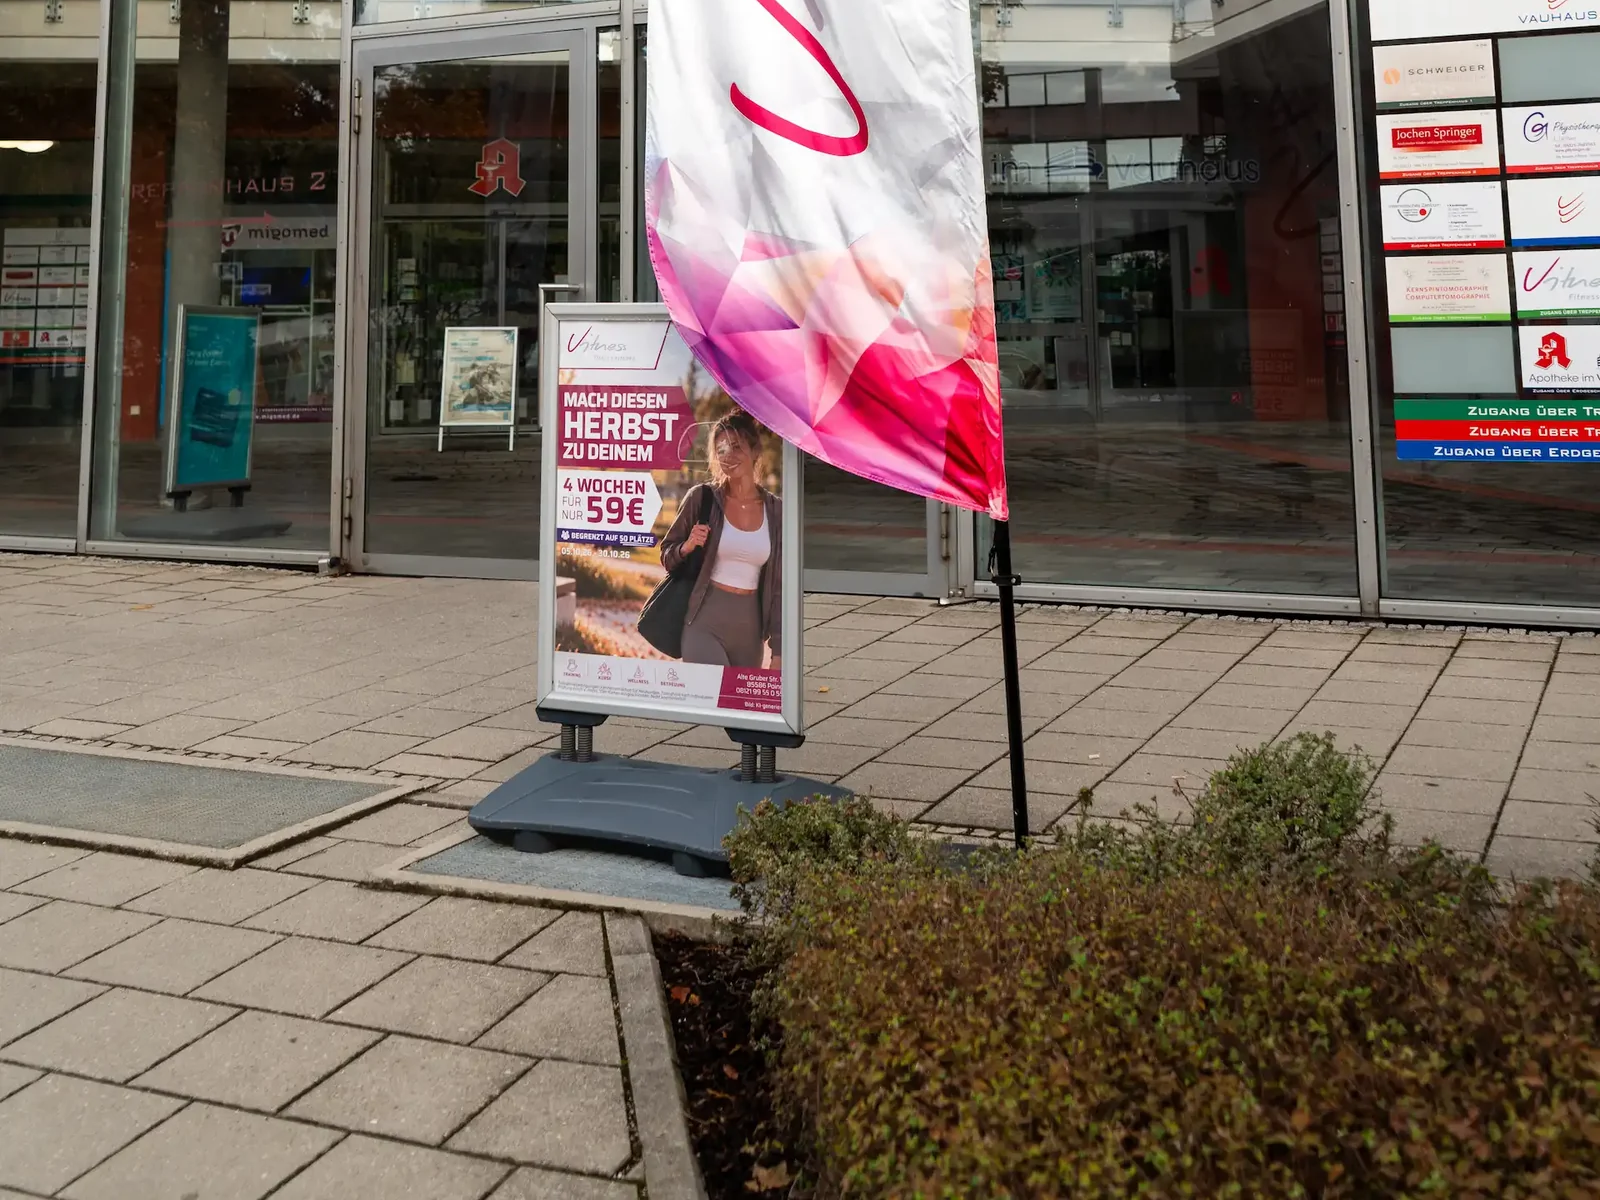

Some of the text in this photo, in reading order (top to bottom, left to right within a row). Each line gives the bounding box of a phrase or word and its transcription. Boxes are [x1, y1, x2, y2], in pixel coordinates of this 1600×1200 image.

[1517, 10, 1598, 24] VAUHAUS
[1408, 64, 1486, 76] SCHWEIGER
[1396, 127, 1477, 140] Jochen Springer
[310, 171, 326, 191] 2
[248, 224, 329, 241] migomed
[1528, 373, 1579, 384] Apotheke
[1581, 373, 1595, 382] im
[563, 391, 668, 409] MACH DIESEN
[1467, 406, 1530, 416] ZUGANG
[1537, 405, 1577, 416] ÜBER
[563, 411, 679, 442] HERBST
[1469, 426, 1532, 437] ZUGANG
[1538, 426, 1579, 437] ÜBER
[562, 442, 653, 462] ZU DEINEM
[1433, 446, 1495, 457] ZUGANG
[1501, 446, 1542, 457] ÜBER
[563, 477, 646, 495] 4 WOCHEN
[562, 495, 582, 507] FÜR
[561, 509, 584, 521] NUR
[587, 495, 644, 526] 59€
[571, 531, 654, 544] BEGRENZT AUF 50 PLÄTZE
[598, 549, 631, 559] 30.10.26
[737, 673, 748, 681] Alte
[749, 674, 768, 682] Gruber
[768, 675, 779, 683] Str.
